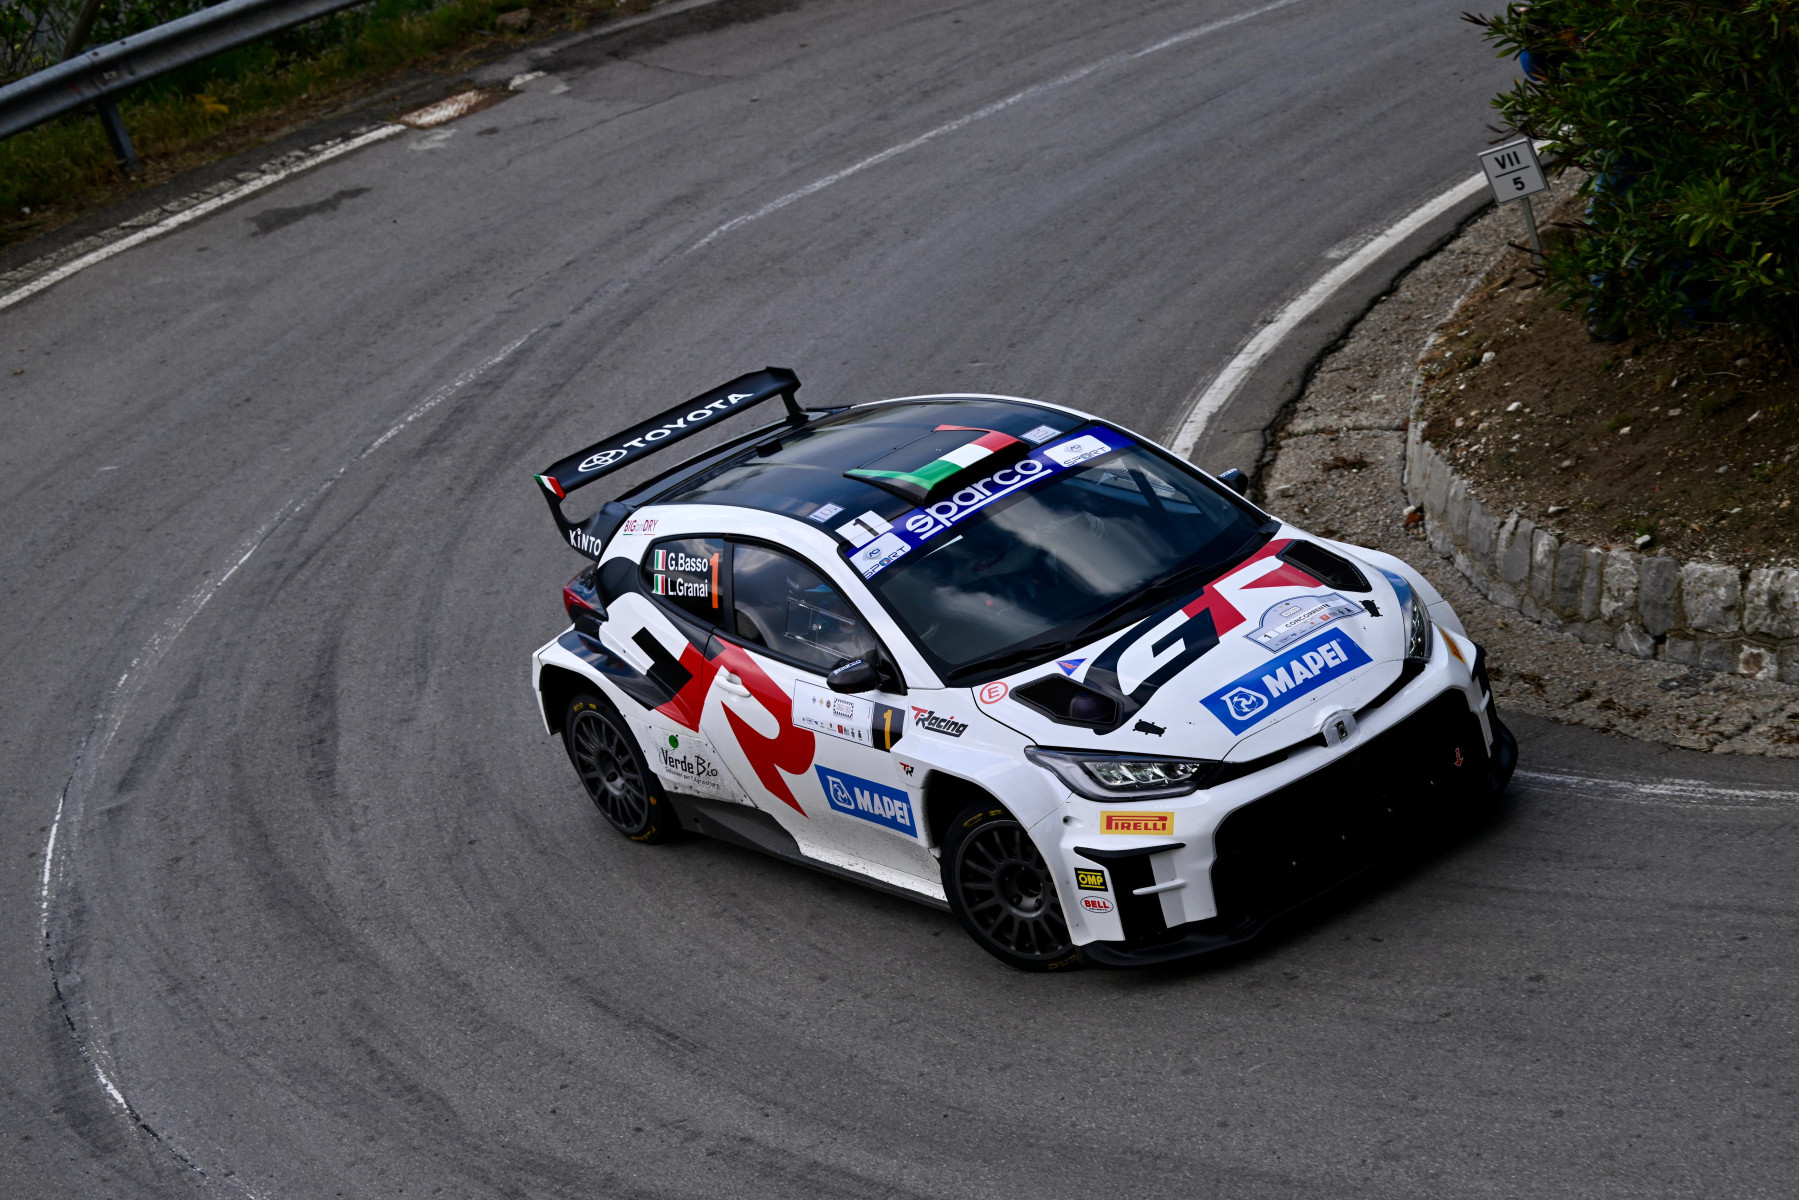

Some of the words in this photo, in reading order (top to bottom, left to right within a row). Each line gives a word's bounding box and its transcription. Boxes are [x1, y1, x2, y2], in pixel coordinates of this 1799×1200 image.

[1494, 151, 1520, 170] VII
[1512, 176, 1525, 191] 5
[623, 392, 754, 449] TOYOTA
[1063, 446, 1106, 467] SPORT
[905, 458, 1044, 533] sparco
[852, 517, 880, 538] 1
[668, 552, 709, 572] G.Basso
[862, 546, 907, 580] SPORT
[668, 577, 708, 597] L.Granai
[709, 552, 720, 609] 1
[1285, 603, 1331, 628] CONCORRENTE
[1261, 643, 1349, 699] MAPEI
[987, 686, 1000, 700] E
[883, 709, 893, 750] 1
[660, 747, 695, 775] Verde
[694, 754, 718, 777] Bio
[853, 787, 910, 827] MAPEI
[1105, 815, 1168, 831] PIRELLI
[1078, 873, 1104, 886] OMP
[1084, 899, 1110, 909] BELL
